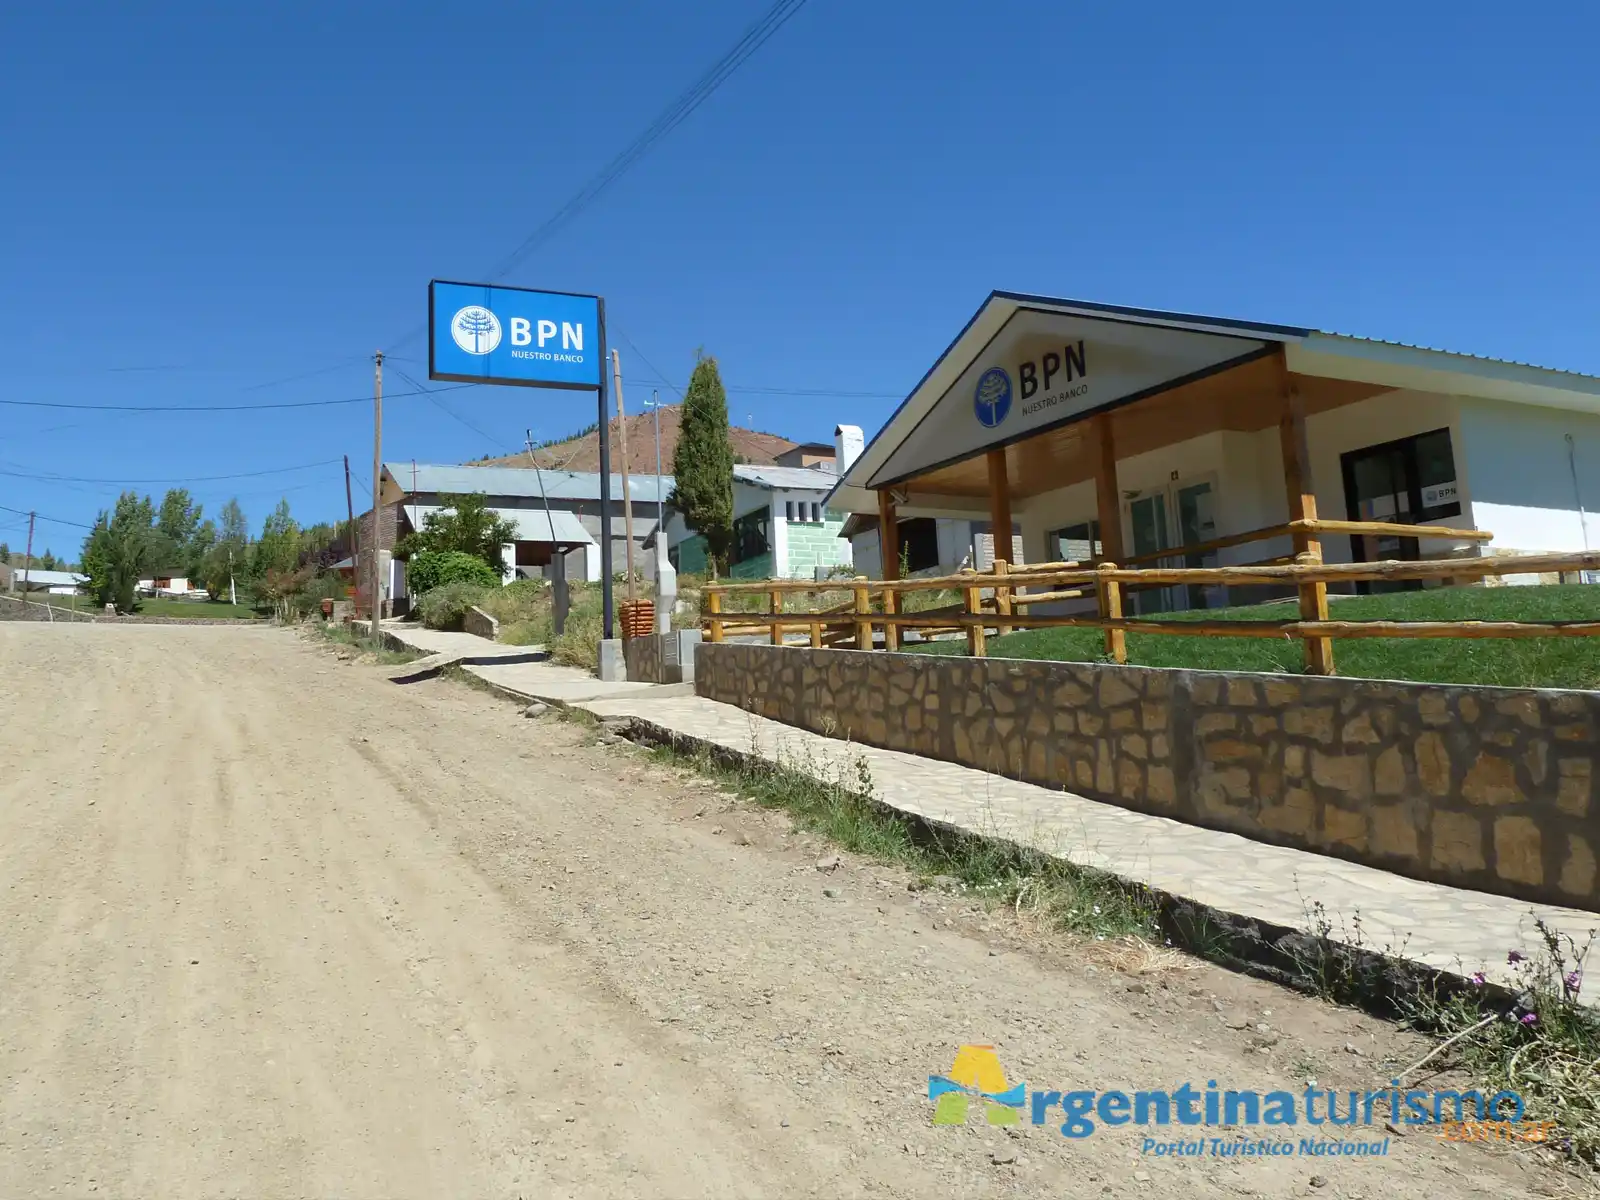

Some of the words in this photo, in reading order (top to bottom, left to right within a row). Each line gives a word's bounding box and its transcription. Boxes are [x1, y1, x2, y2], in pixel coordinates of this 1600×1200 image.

[510, 317, 583, 350] BPN
[511, 350, 552, 361] NUESTRO
[553, 353, 584, 363] BANCO
[1019, 340, 1086, 400] BPN
[1022, 395, 1057, 416] NUESTRO
[1059, 384, 1088, 403] BANCO
[1438, 487, 1456, 498] BPN
